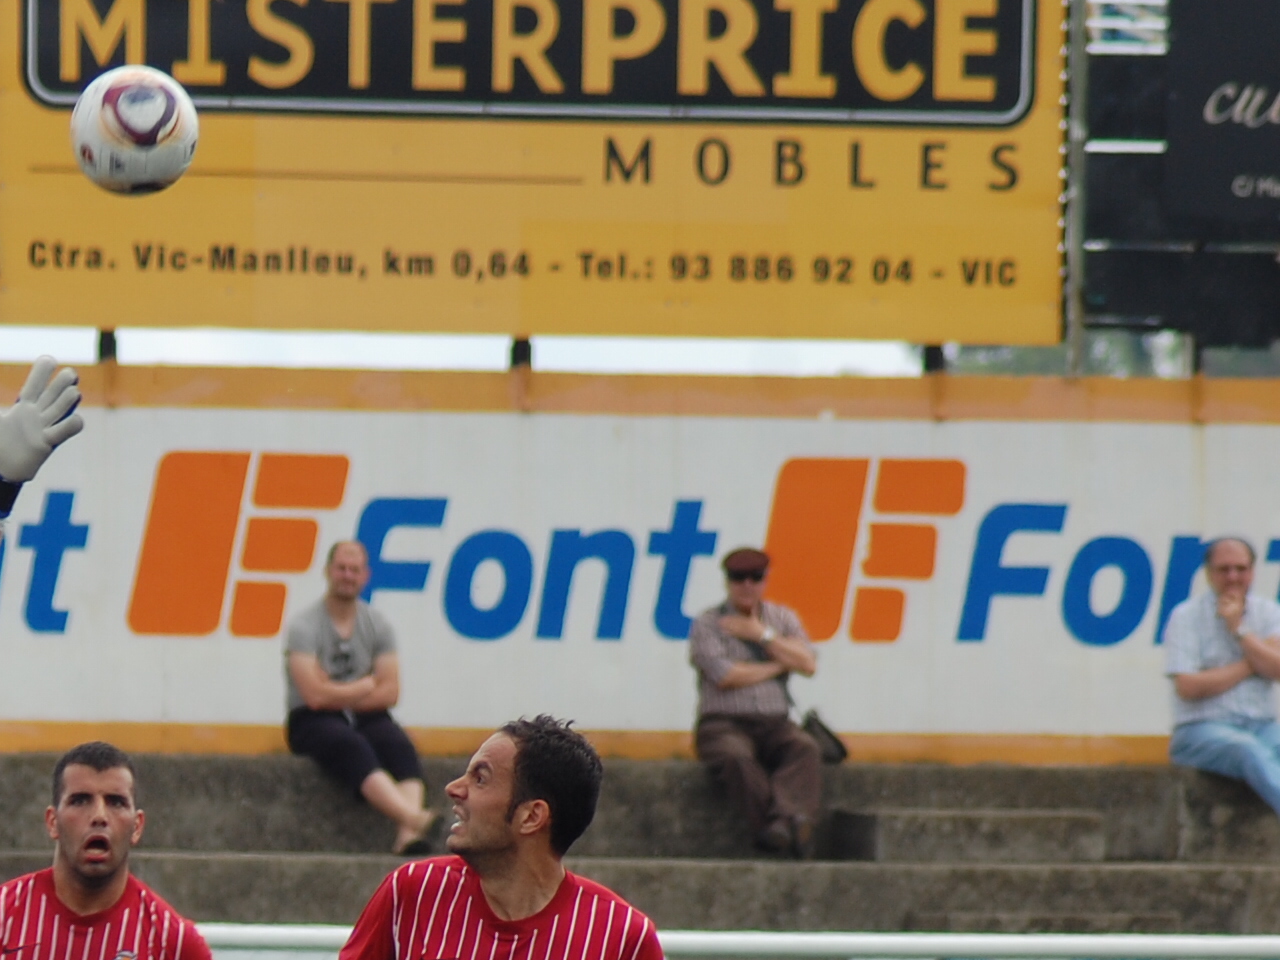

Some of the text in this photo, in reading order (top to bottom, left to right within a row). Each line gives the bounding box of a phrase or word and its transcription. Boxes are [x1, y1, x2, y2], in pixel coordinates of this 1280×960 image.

[60, 0, 998, 101] MISTERPRICE
[602, 136, 1021, 193] MOBLES
[27, 240, 117, 271] Ctra.
[132, 243, 368, 281] Vic-Manlleu,
[382, 250, 435, 277] km
[452, 250, 531, 283] 0,64
[577, 253, 655, 281] Tel.:
[670, 254, 712, 282] 93
[729, 255, 795, 283] 886
[812, 257, 855, 285] 92
[872, 258, 913, 285] 04
[960, 259, 1018, 287] VIC
[352, 496, 718, 641] Font
